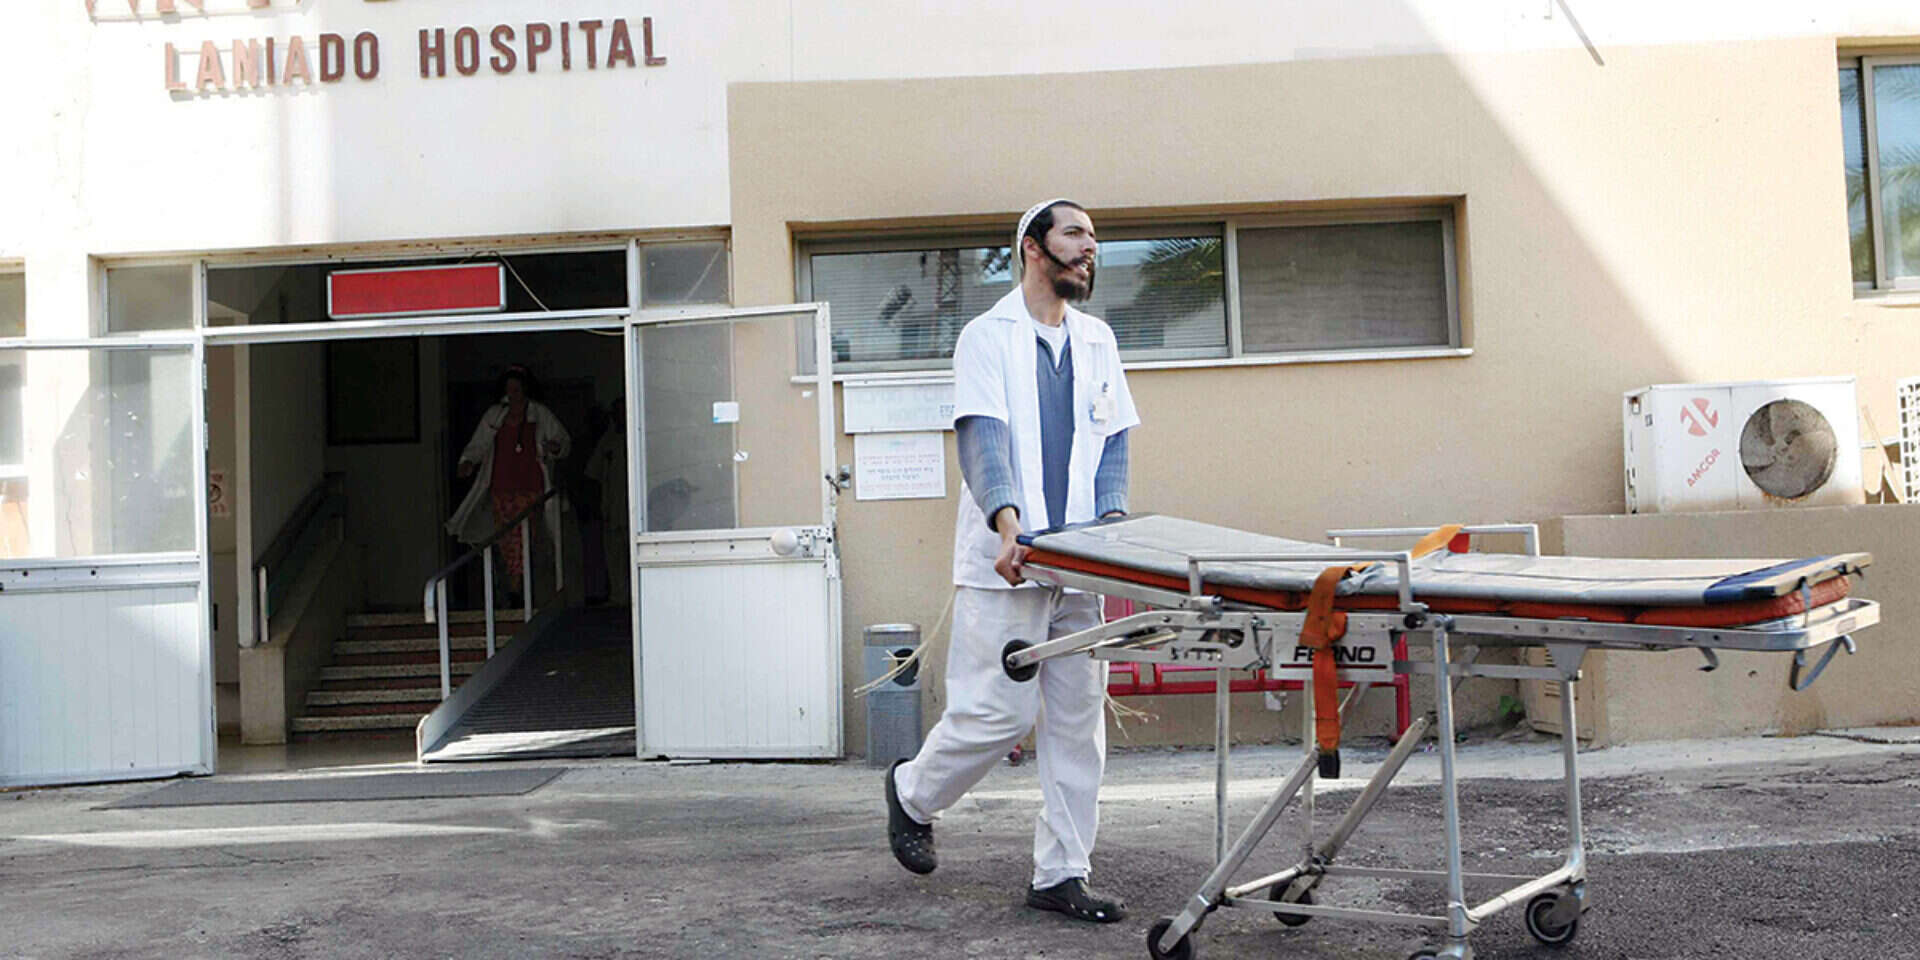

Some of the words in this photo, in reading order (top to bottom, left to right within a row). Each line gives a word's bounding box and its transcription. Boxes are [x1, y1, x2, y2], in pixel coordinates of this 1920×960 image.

[165, 31, 380, 90] LANIADO
[419, 17, 667, 78] HOSPITAL
[1687, 448, 1721, 487] AMCOR
